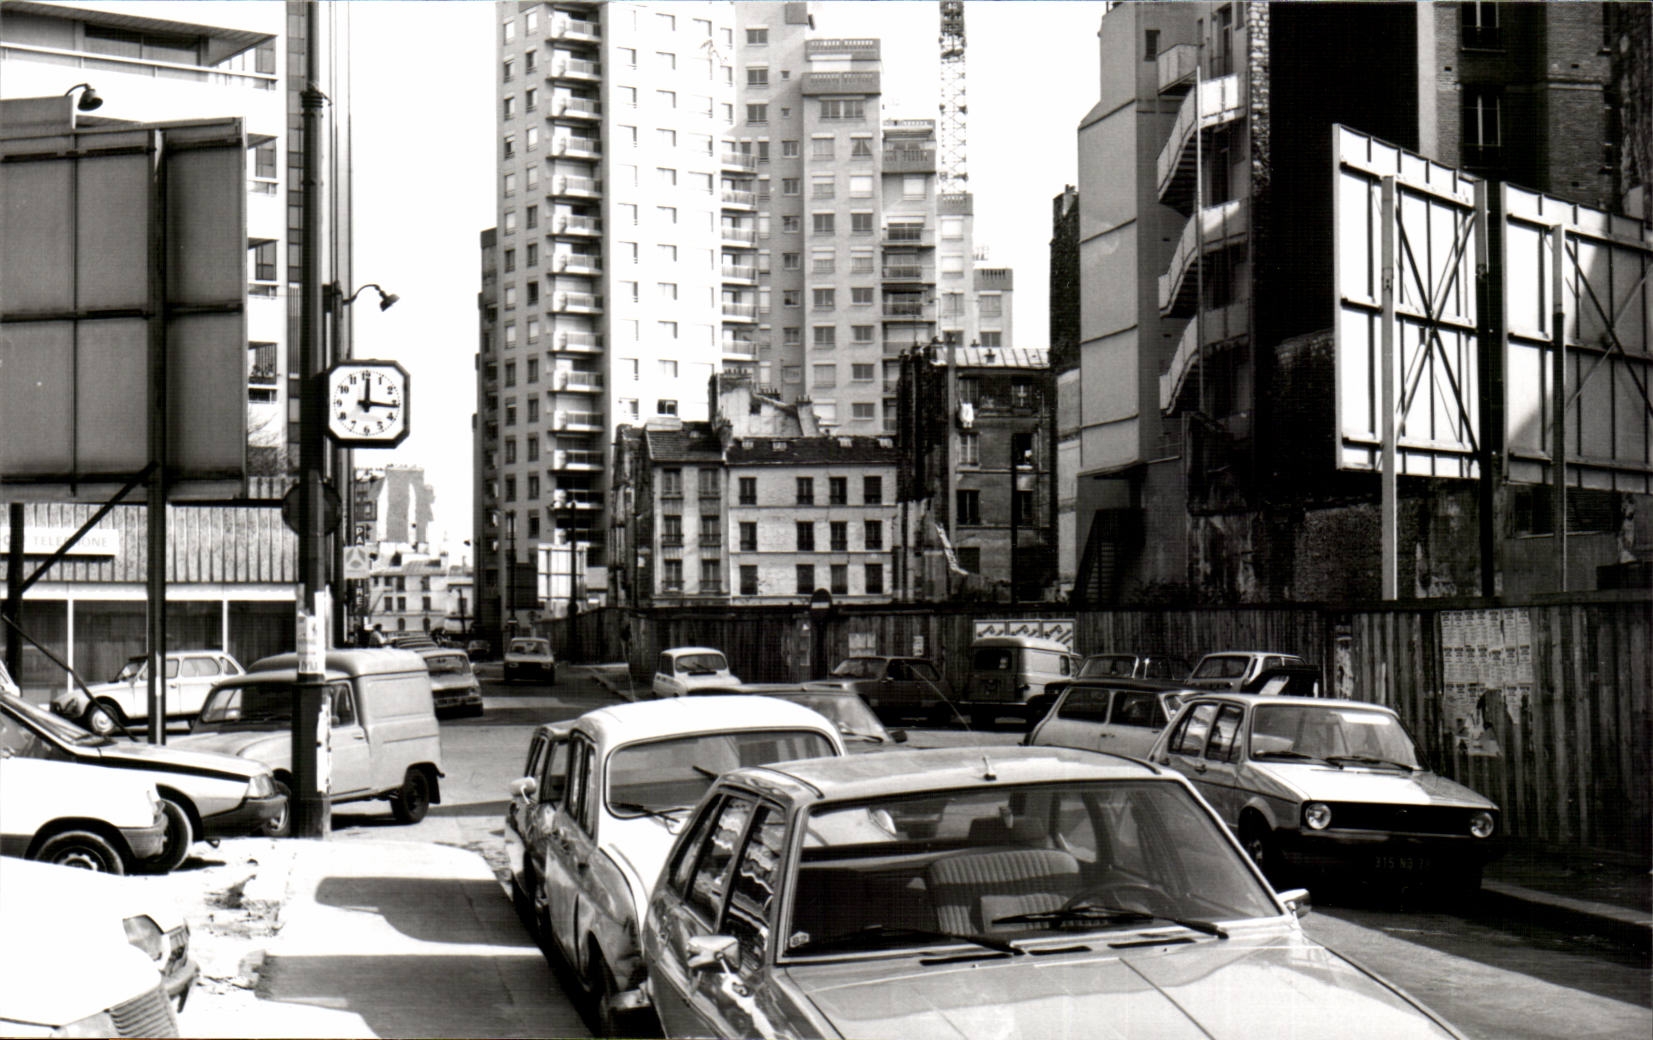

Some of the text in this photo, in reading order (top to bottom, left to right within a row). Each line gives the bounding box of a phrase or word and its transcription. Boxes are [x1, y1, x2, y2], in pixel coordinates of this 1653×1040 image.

[350, 376, 356, 385] 11
[340, 385, 349, 394] 10
[387, 386, 393, 395] 2
[336, 399, 342, 407] 9
[386, 412, 393, 420] 4
[363, 426, 370, 434] 6
[376, 421, 383, 430] 5
[33, 536, 108, 548] TELEONE
